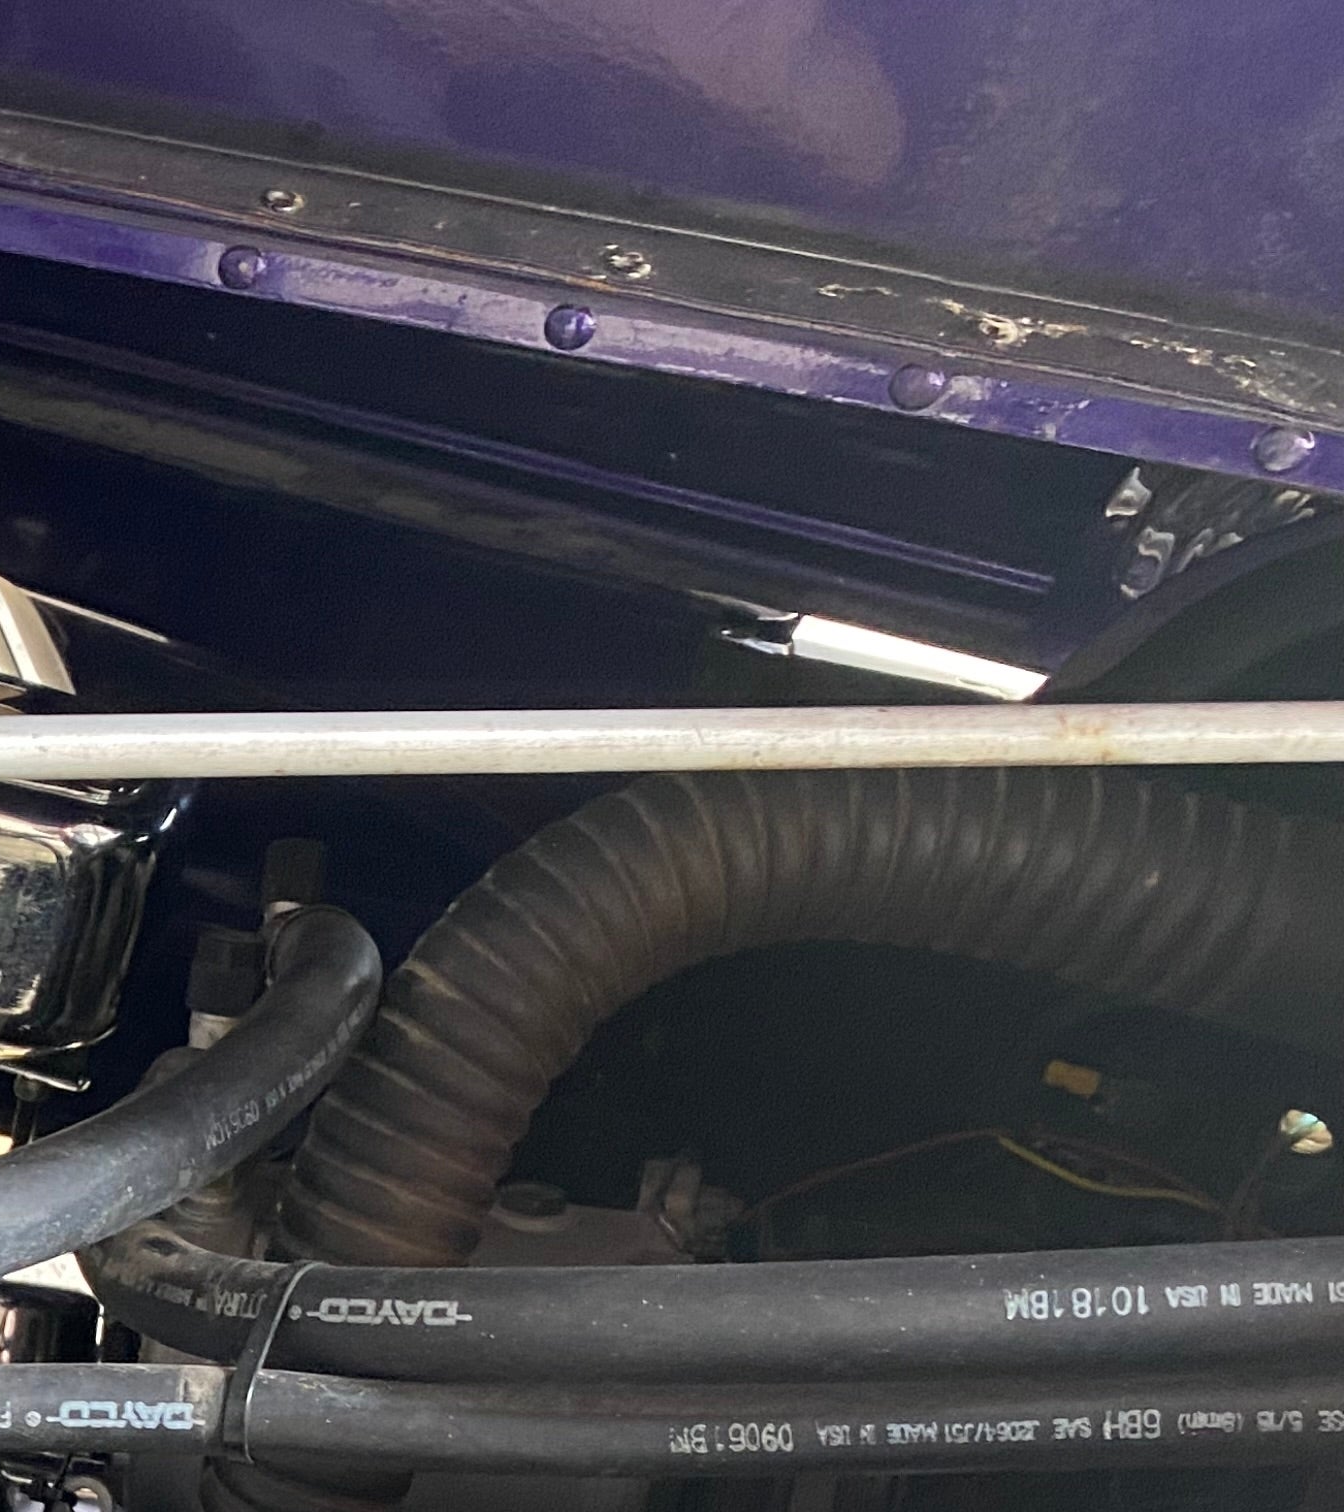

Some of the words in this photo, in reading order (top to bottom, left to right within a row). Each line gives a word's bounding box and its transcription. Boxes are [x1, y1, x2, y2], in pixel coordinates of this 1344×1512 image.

[1164, 1284, 1209, 1309] USA
[1219, 1282, 1241, 1307] IN
[1252, 1281, 1313, 1305] MADE
[305, 1298, 472, 1326] DAYCO
[45, 1400, 206, 1430] DAYCO
[1103, 1408, 1162, 1441] 6BH
[814, 1421, 852, 1446] USA
[886, 1421, 939, 1445] MADE
[1052, 1417, 1092, 1440] SAE
